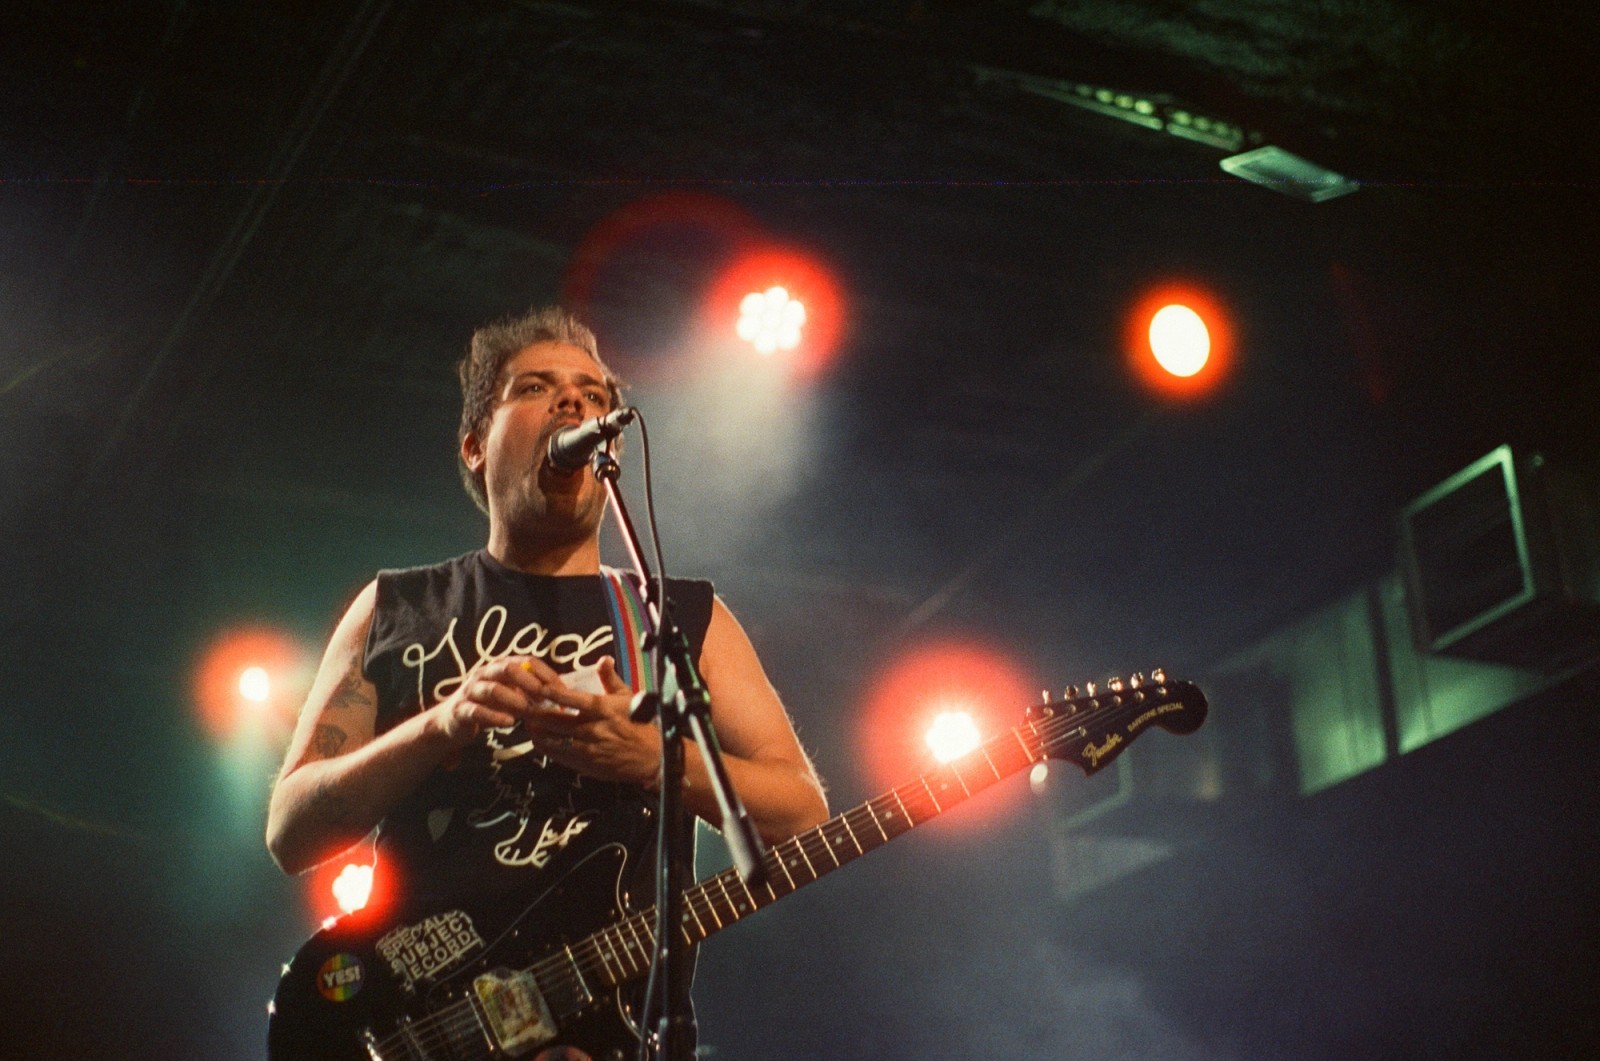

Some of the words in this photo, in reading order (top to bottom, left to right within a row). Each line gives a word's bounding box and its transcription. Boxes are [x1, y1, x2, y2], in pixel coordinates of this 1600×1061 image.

[1157, 702, 1184, 714] SPECIAL
[1082, 733, 1122, 767] Fender
[323, 965, 361, 988] YES!
